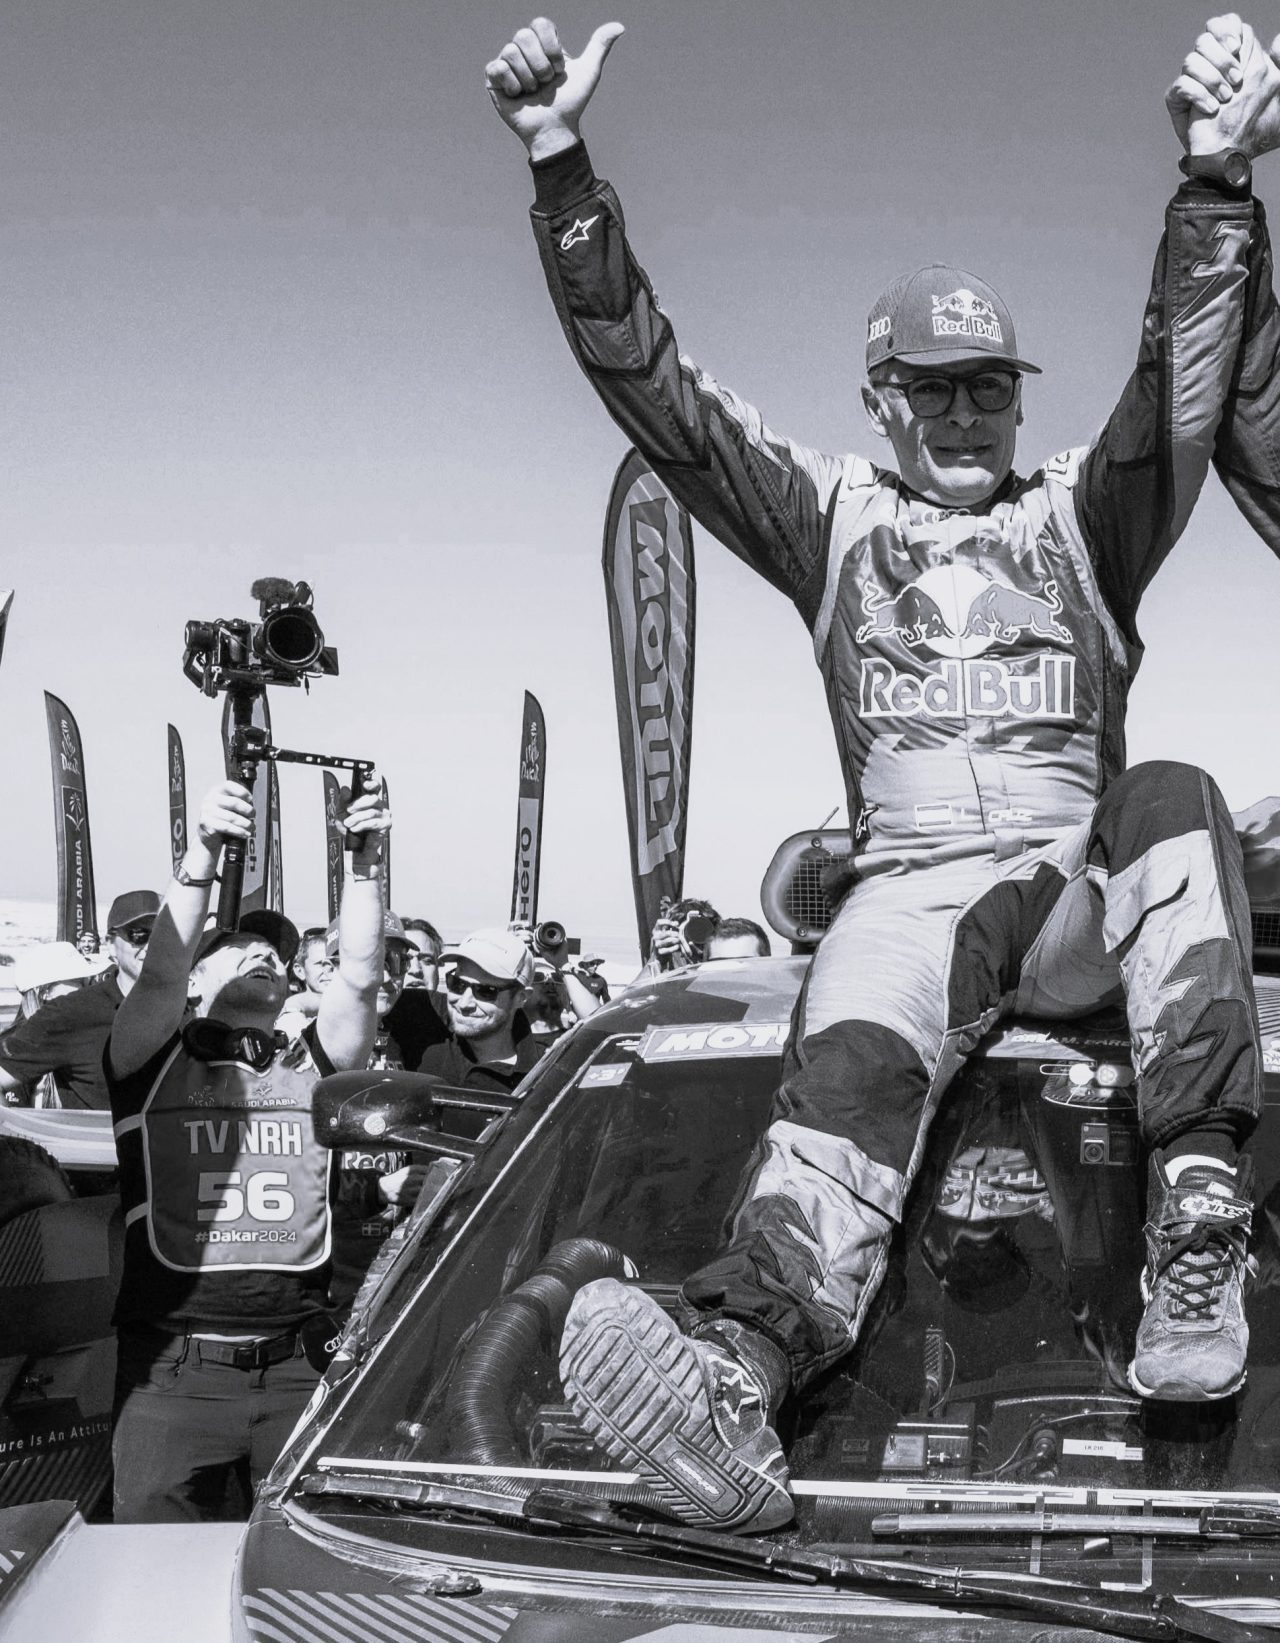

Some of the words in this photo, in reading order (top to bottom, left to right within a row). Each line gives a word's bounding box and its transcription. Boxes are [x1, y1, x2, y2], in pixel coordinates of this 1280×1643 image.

[932, 316, 970, 336] Red
[971, 317, 1003, 343] Bull
[635, 519, 673, 822] MOTUL
[859, 657, 963, 718] Red
[963, 655, 1076, 719] Bull
[74, 839, 83, 900] ARABIA
[519, 826, 532, 922] Hero
[655, 1026, 790, 1052] MOT
[231, 1099, 260, 1108] SAUDI
[263, 1098, 298, 1107] ARABIA
[183, 1120, 230, 1155] TV
[238, 1120, 303, 1156] NRH
[197, 1170, 295, 1223] 56
[194, 1229, 297, 1243] #Dakar2024
[0, 1438, 24, 1454] ure
[30, 1434, 43, 1447] Is
[48, 1430, 65, 1443] An
[70, 1422, 109, 1439] Attitu
